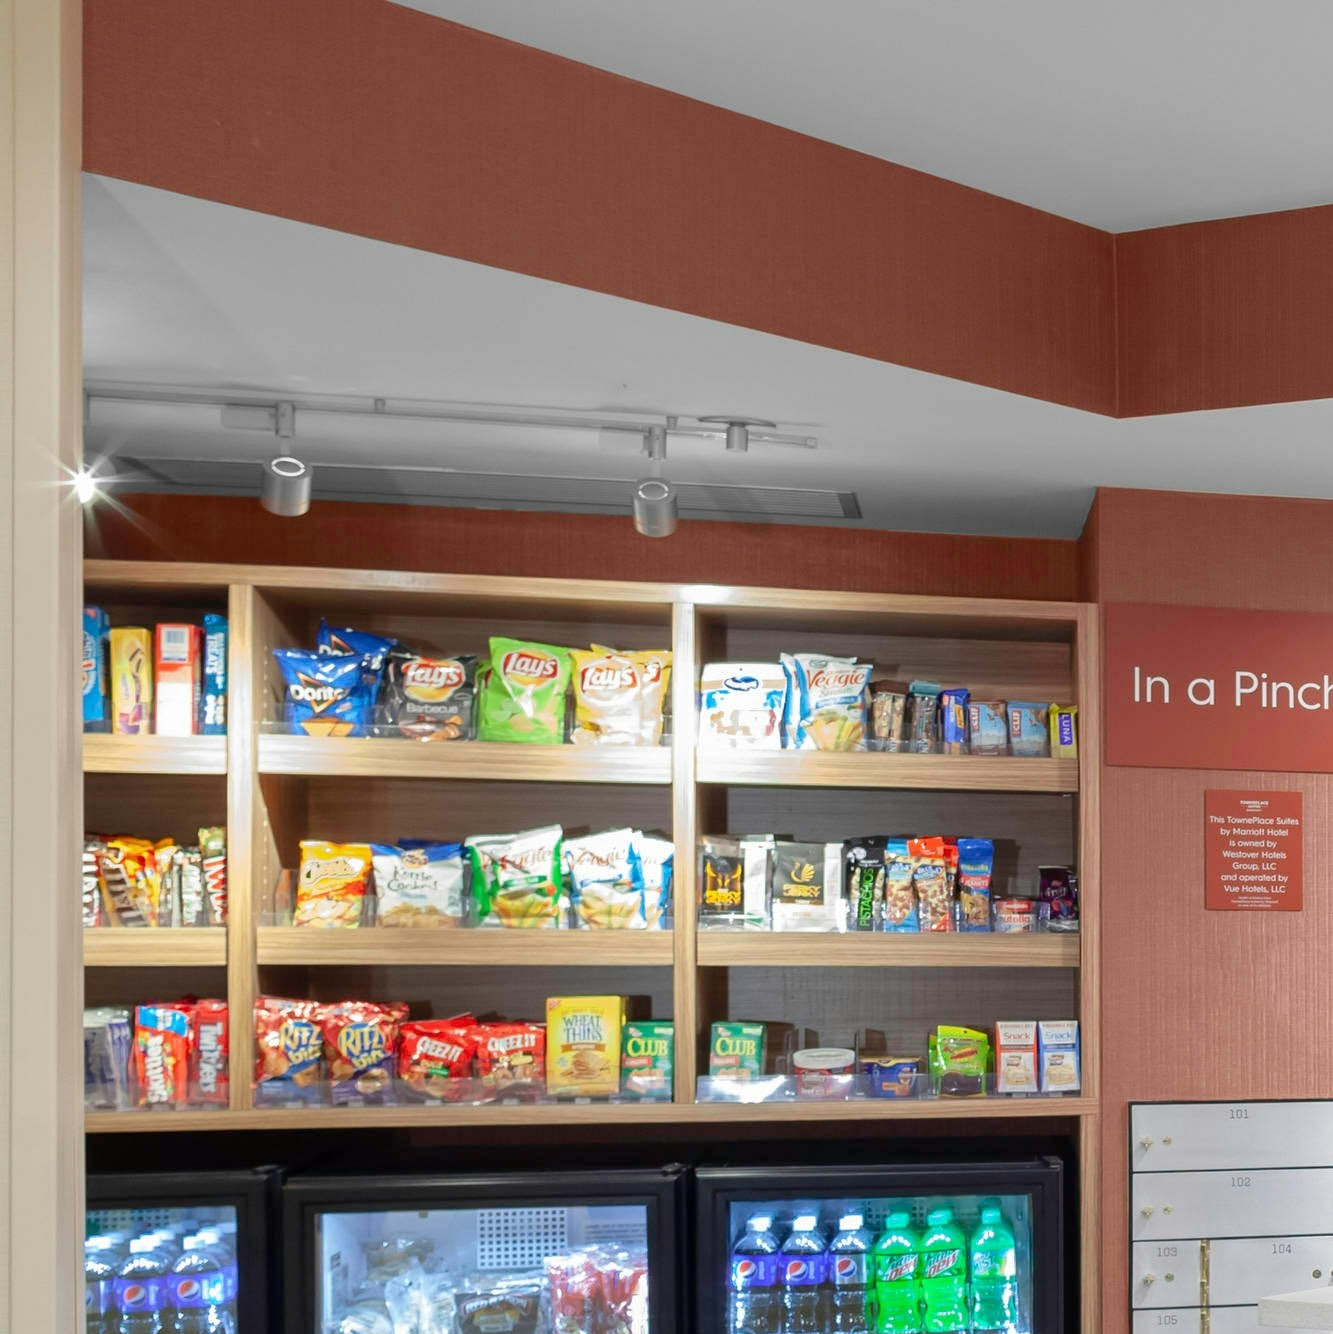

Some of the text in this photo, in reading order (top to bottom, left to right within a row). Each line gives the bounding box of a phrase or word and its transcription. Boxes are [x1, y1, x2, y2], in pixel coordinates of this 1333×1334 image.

[807, 670, 864, 689] Veggie
[1135, 667, 1169, 703] In
[1188, 678, 1214, 705] a
[407, 703, 458, 713] Barbecue
[1061, 714, 1070, 744] LUNA
[1227, 816, 1274, 824] TownePlace
[1276, 817, 1299, 825] Suites
[1220, 828, 1231, 836] by
[1233, 828, 1265, 836] Marriott
[1267, 840, 1277, 848] by
[1223, 850, 1259, 858] Westover
[1239, 874, 1276, 882] operated
[1278, 875, 1288, 883] by
[1242, 885, 1269, 893] Hotels,
[563, 1015, 601, 1030] WHEAT
[565, 1028, 603, 1042] THINS
[1004, 1032, 1030, 1040] Snack
[627, 1038, 668, 1057] CLUB
[716, 1038, 756, 1057] CLUB
[1230, 1109, 1248, 1119] 101
[1232, 1177, 1251, 1187] 102
[1158, 1247, 1177, 1257] 103
[1272, 1244, 1291, 1254] 104
[1158, 1315, 1178, 1325] 105
